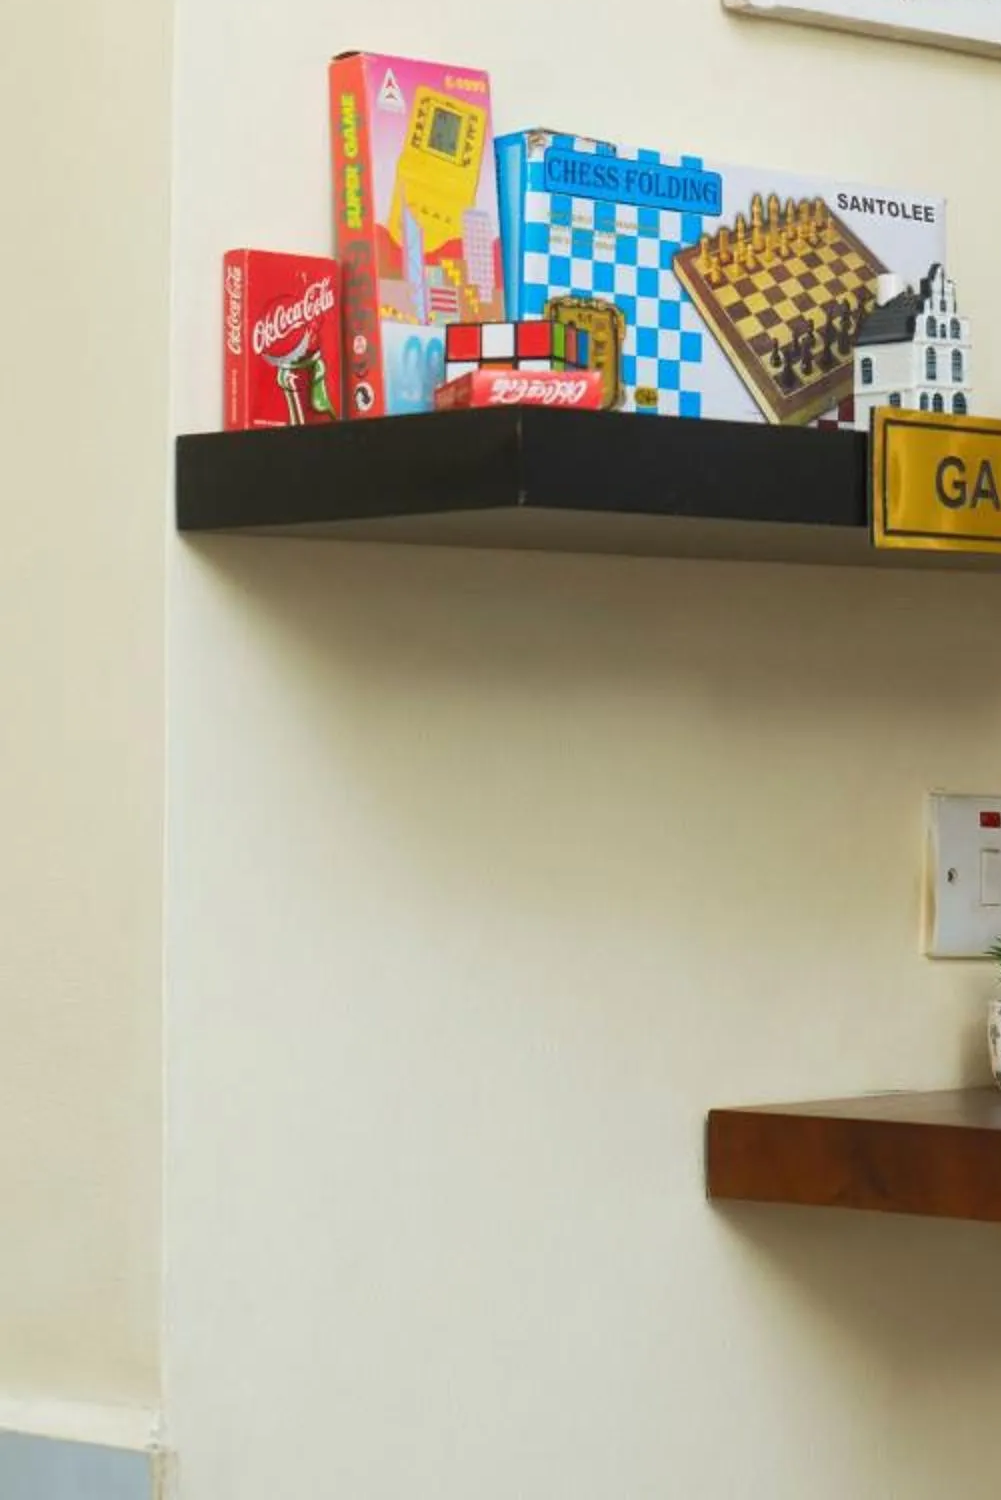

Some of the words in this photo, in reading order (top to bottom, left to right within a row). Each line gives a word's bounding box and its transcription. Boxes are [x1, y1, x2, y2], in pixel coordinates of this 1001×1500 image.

[340, 92, 359, 159] GAME
[546, 157, 620, 190] CHESS
[625, 169, 719, 205] FOLDING
[836, 192, 936, 224] SANTOLEE
